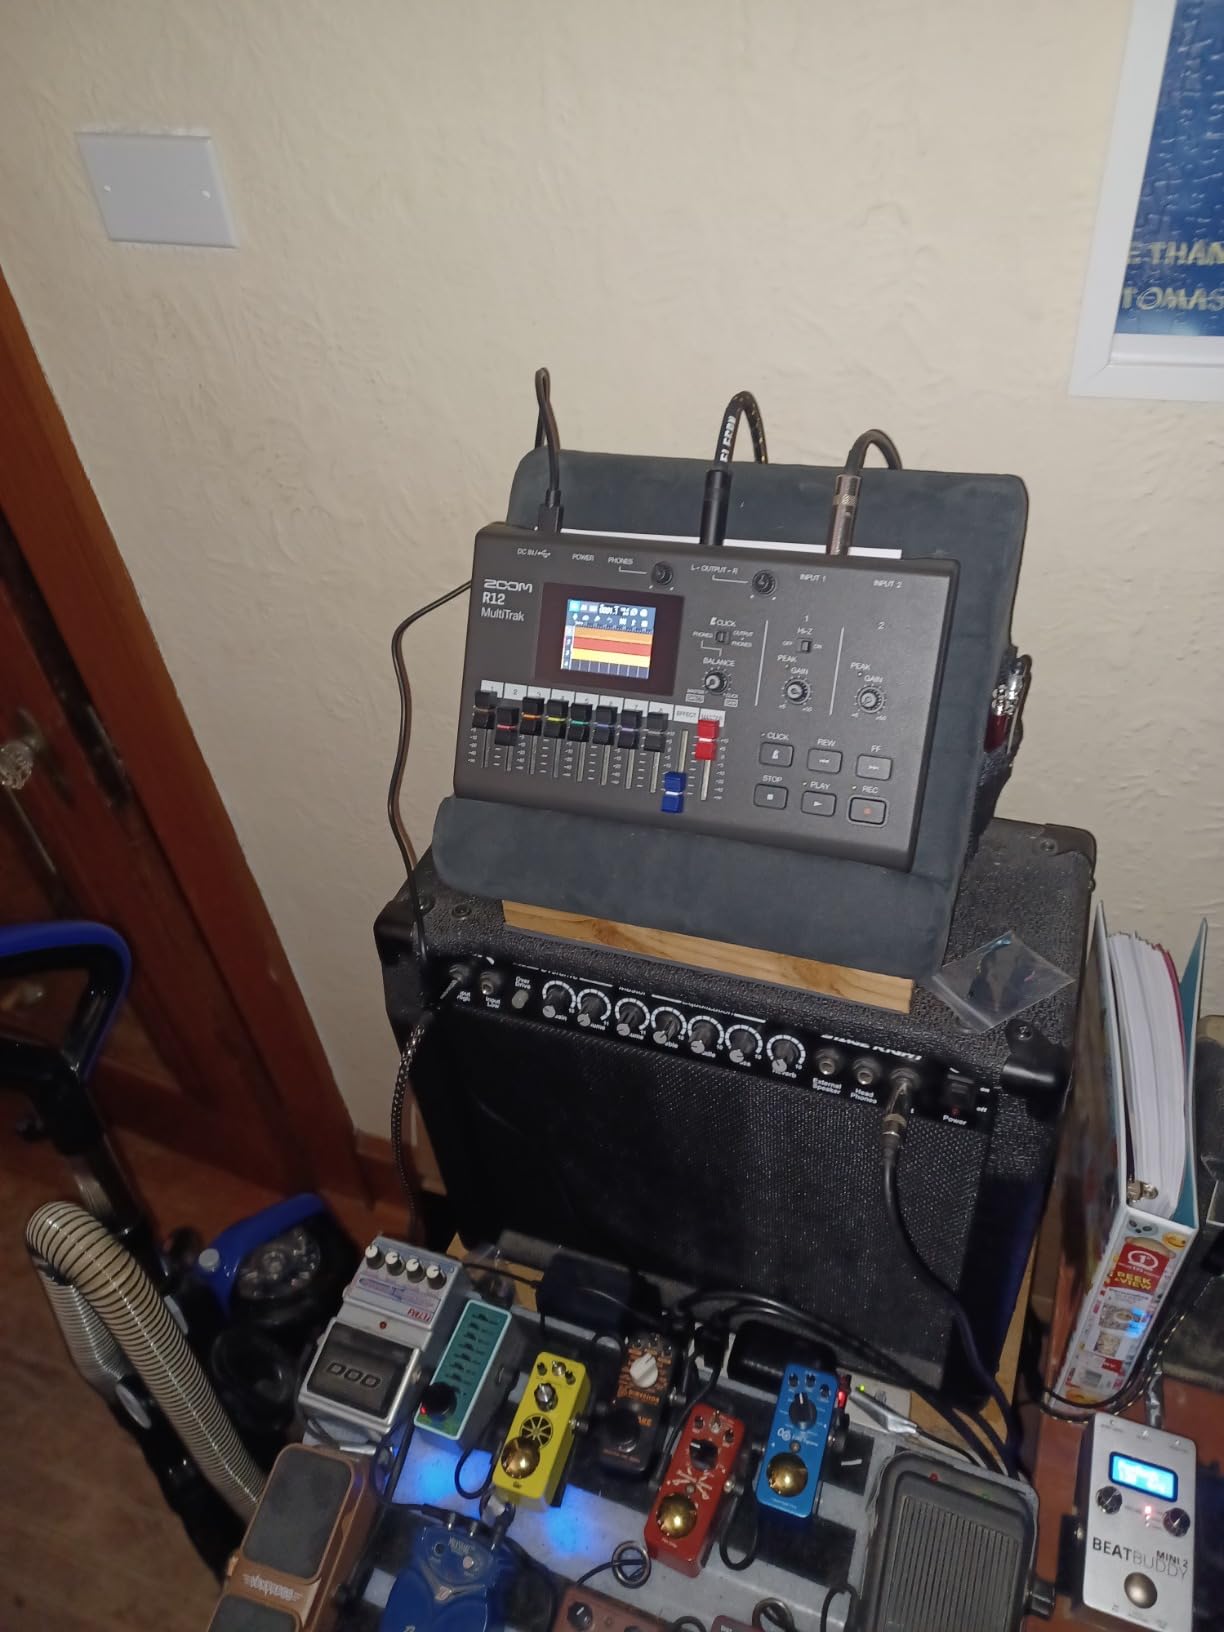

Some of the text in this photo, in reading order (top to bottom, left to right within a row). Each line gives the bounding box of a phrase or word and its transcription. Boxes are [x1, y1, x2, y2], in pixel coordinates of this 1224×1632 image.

[572, 553, 594, 561] POWER
[608, 556, 634, 565] PHONES
[701, 564, 726, 573] OUTPUT
[800, 574, 820, 582] INPUT
[484, 578, 533, 593] ZOOM
[873, 579, 895, 588] INPUT
[482, 591, 506, 606] R12
[480, 606, 525, 622] MultiTrak
[716, 619, 736, 628] CLICK
[877, 621, 885, 630] 2
[702, 656, 736, 667] BALANCE
[776, 654, 798, 663] PEAK
[850, 661, 872, 671] PEAK
[790, 666, 809, 676] GAIN
[864, 674, 884, 683] GAIN
[766, 731, 790, 740] CLICK
[816, 738, 836, 747] REW
[870, 744, 882, 752] FF
[762, 774, 783, 782] STOP
[810, 781, 831, 790] PLAY
[862, 785, 879, 794] REC
[516, 976, 530, 984] Over
[514, 981, 531, 990] Drive
[812, 1077, 842, 1090] External
[812, 1083, 841, 1095] Speaker
[855, 1088, 874, 1098] Head
[850, 1092, 878, 1104] Phones
[942, 1114, 968, 1126] Power
[1156, 1550, 1189, 1568] MINI 2
